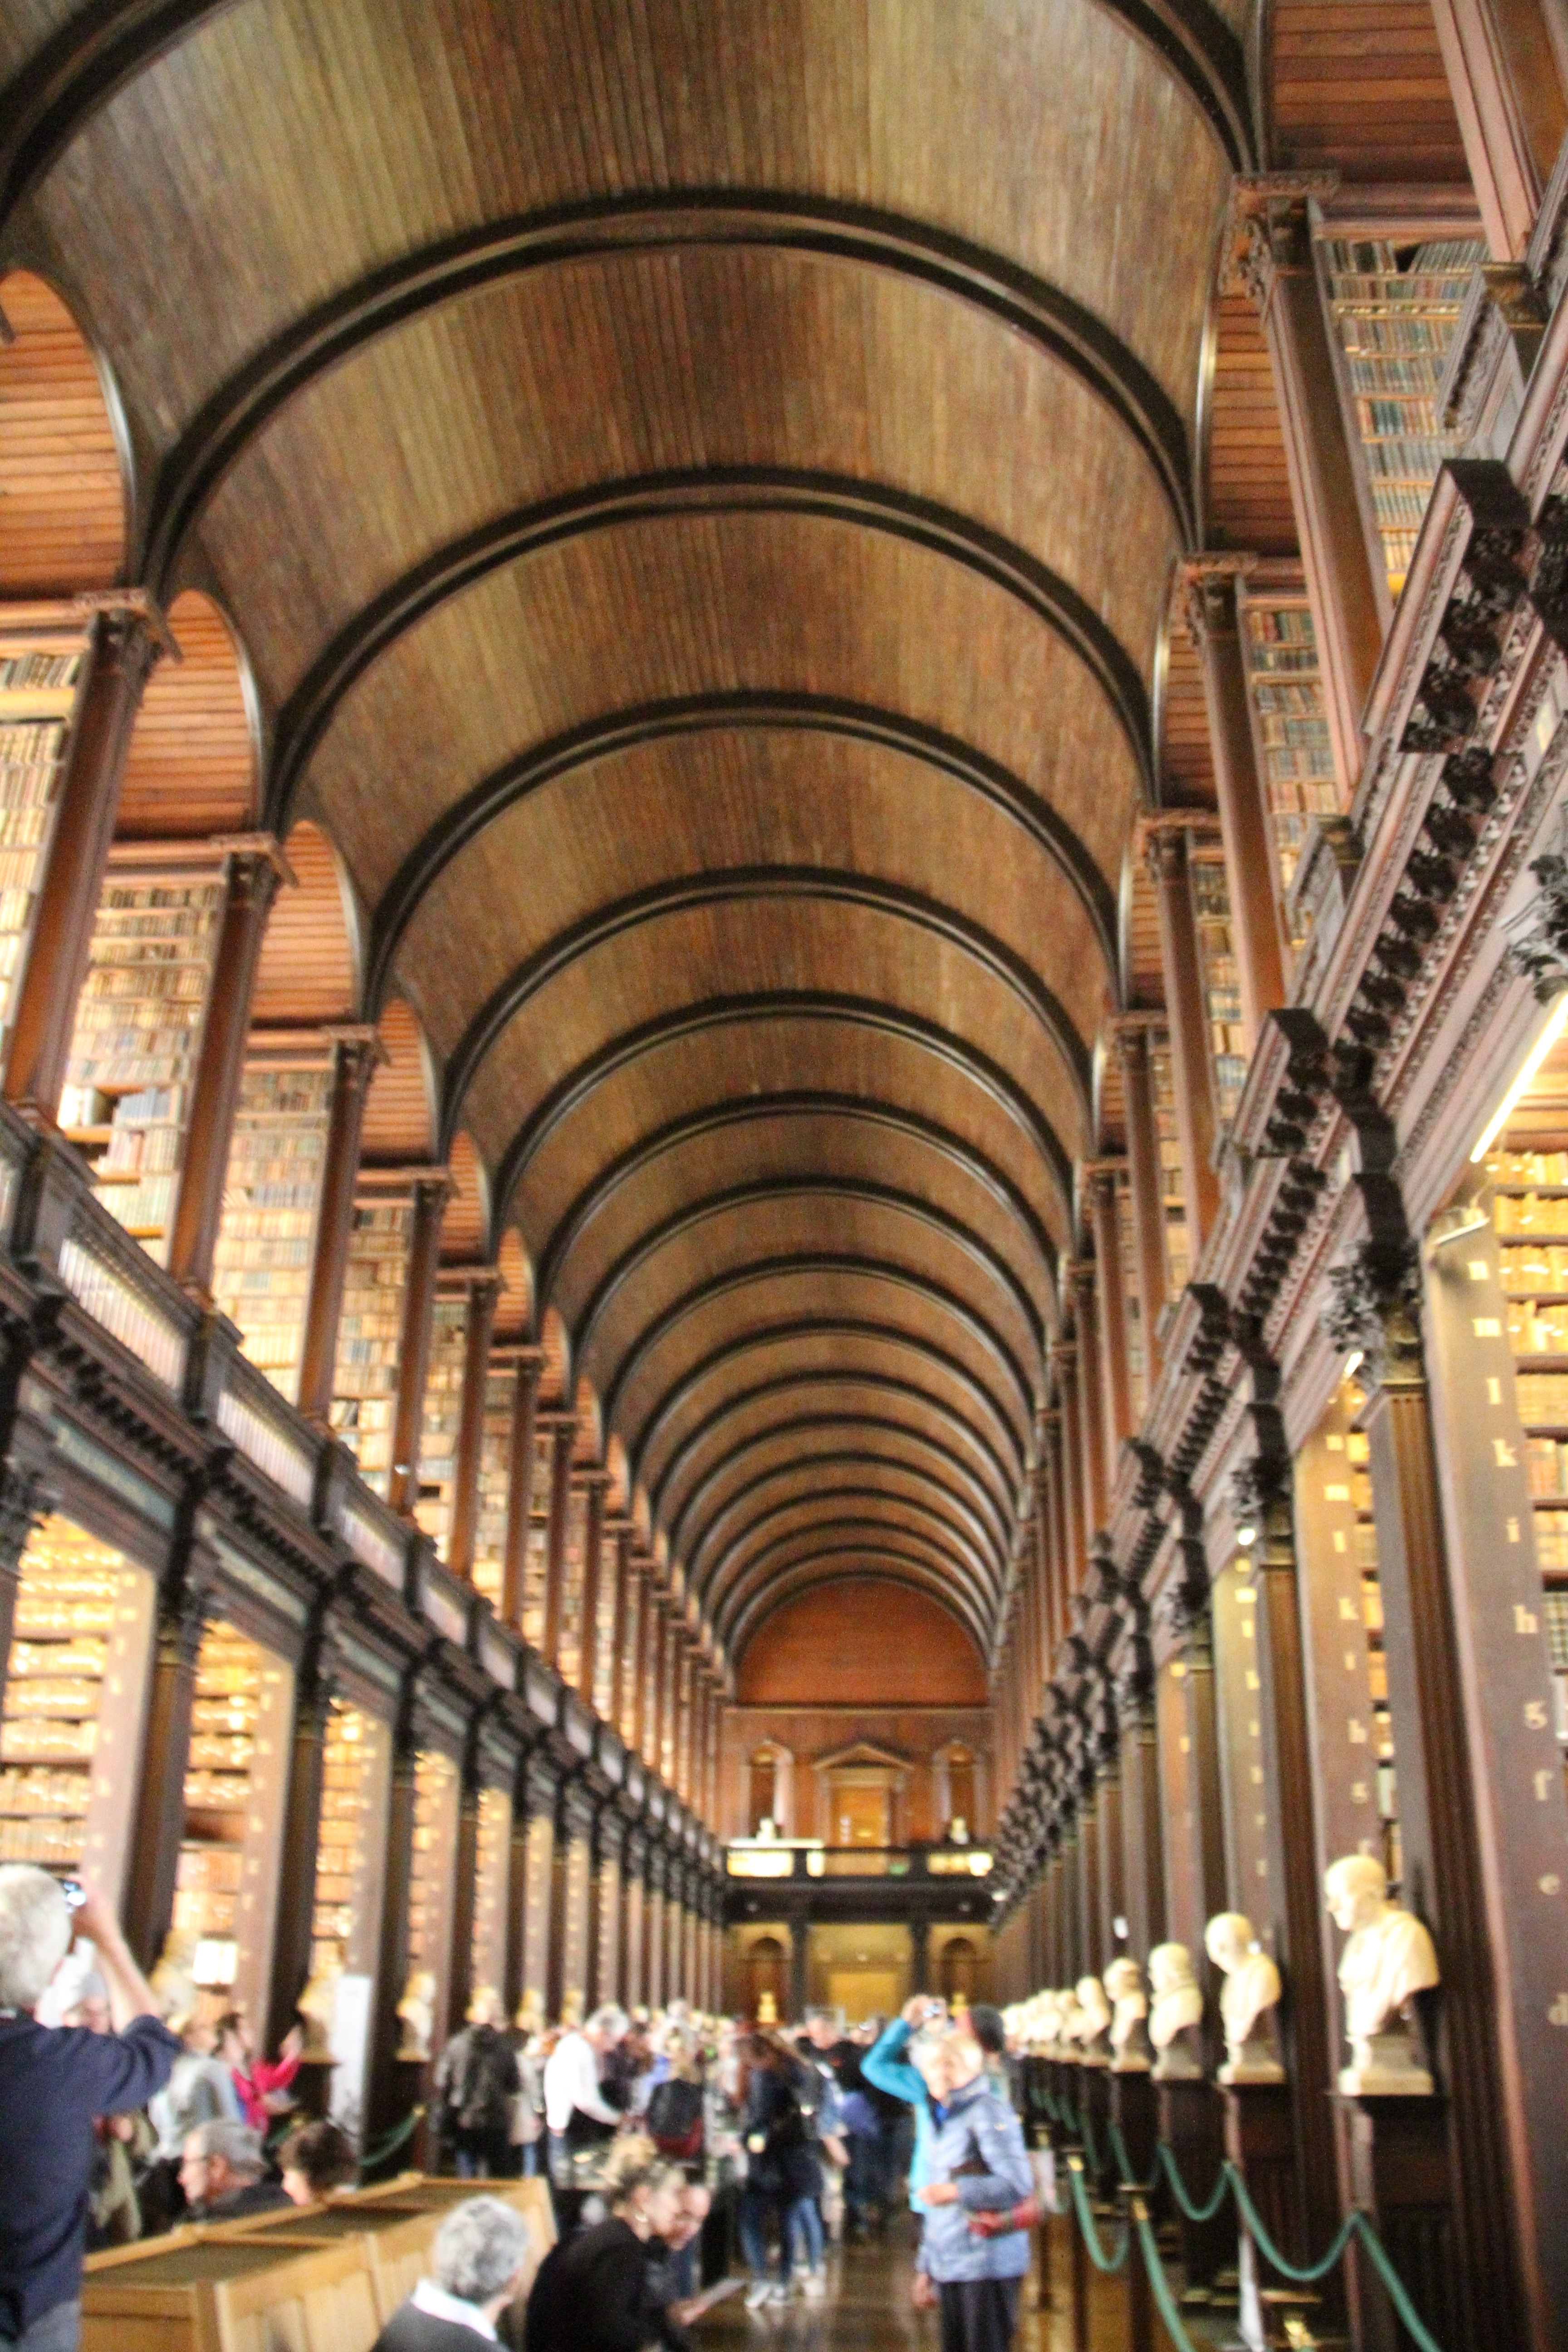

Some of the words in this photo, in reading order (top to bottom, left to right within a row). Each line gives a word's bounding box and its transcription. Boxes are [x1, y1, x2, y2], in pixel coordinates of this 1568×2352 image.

[1494, 1439, 1516, 1467] k
[1507, 1517, 1520, 1543] i
[1514, 1605, 1538, 1633] h
[1524, 1700, 1548, 1730] g
[1539, 1873, 1560, 1896] e
